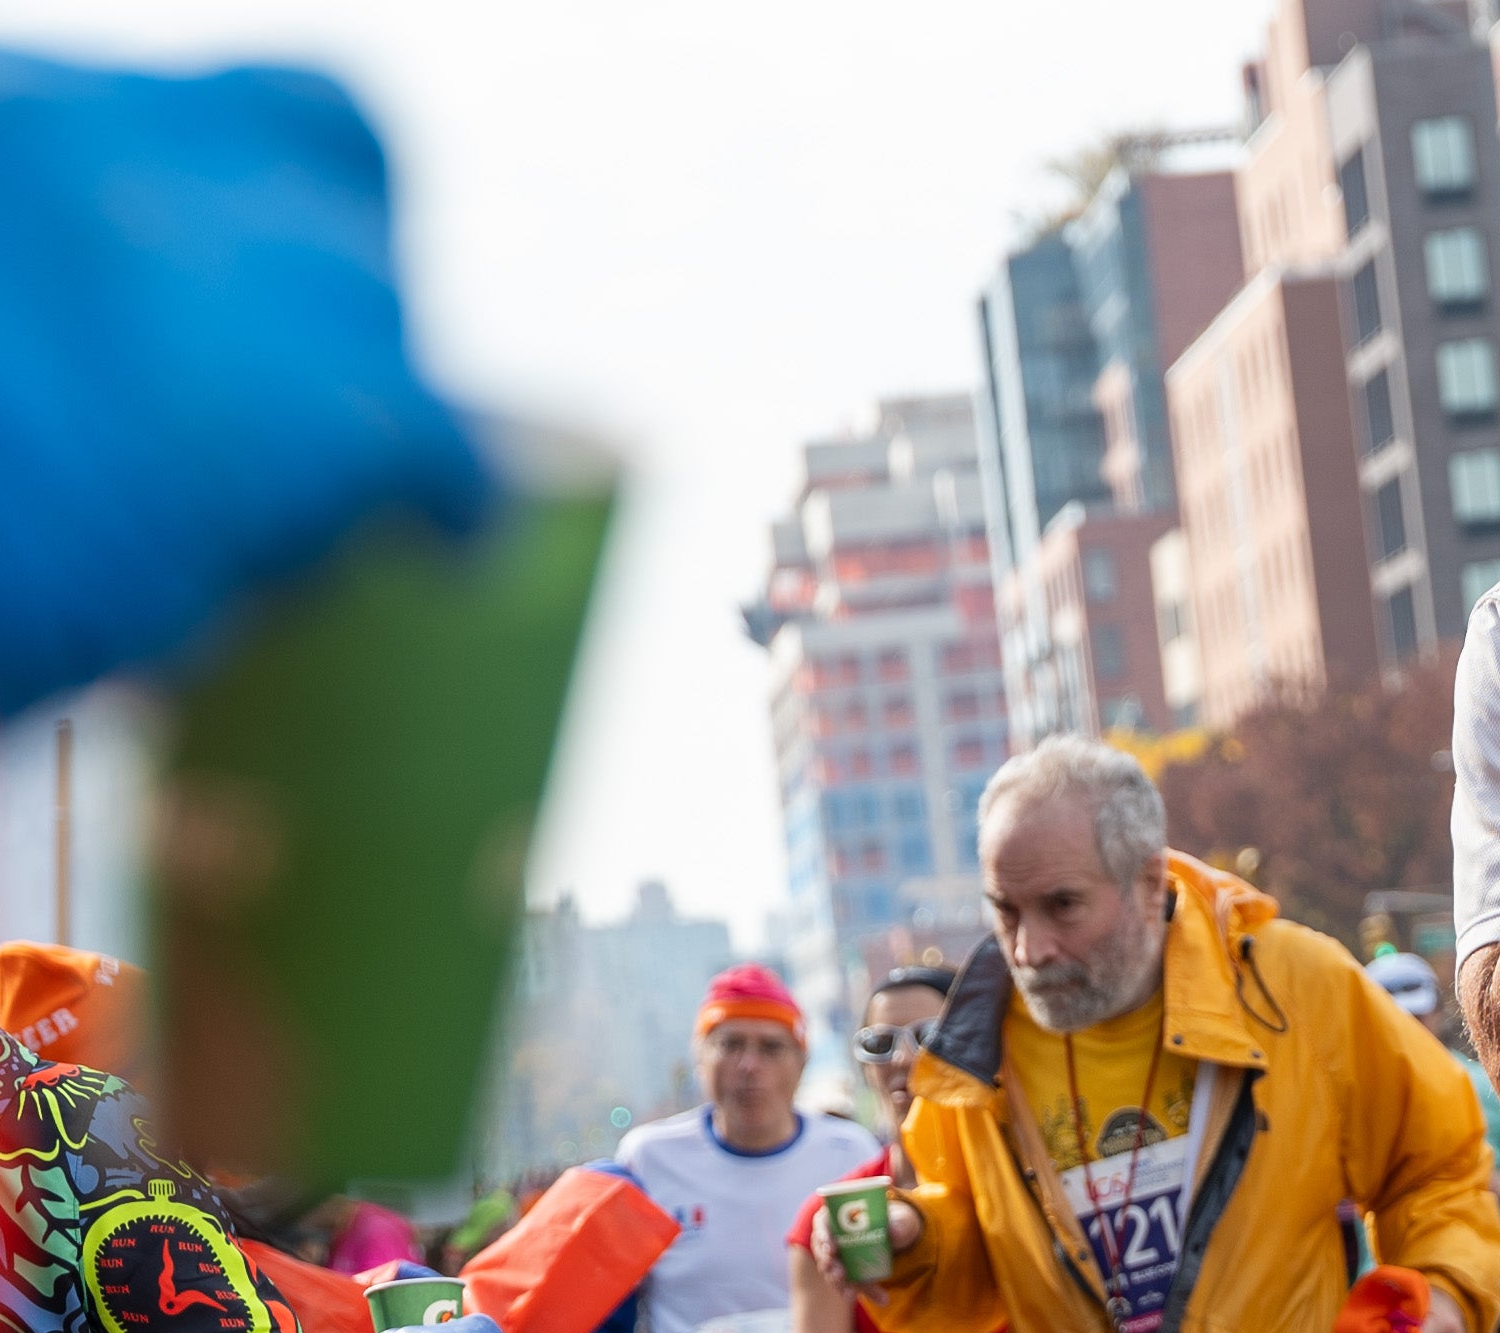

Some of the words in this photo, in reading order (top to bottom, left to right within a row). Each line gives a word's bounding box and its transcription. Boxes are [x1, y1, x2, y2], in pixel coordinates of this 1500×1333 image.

[150, 1224, 175, 1234] RUN
[1088, 1195, 1184, 1270] 121
[112, 1238, 137, 1248] RUN
[178, 1241, 203, 1253] RUN
[100, 1258, 124, 1268] RUN
[198, 1262, 221, 1274] RUN
[104, 1284, 131, 1295] RUN
[215, 1289, 239, 1300] RUN
[121, 1310, 150, 1324] RUN
[219, 1317, 245, 1328] RUN
